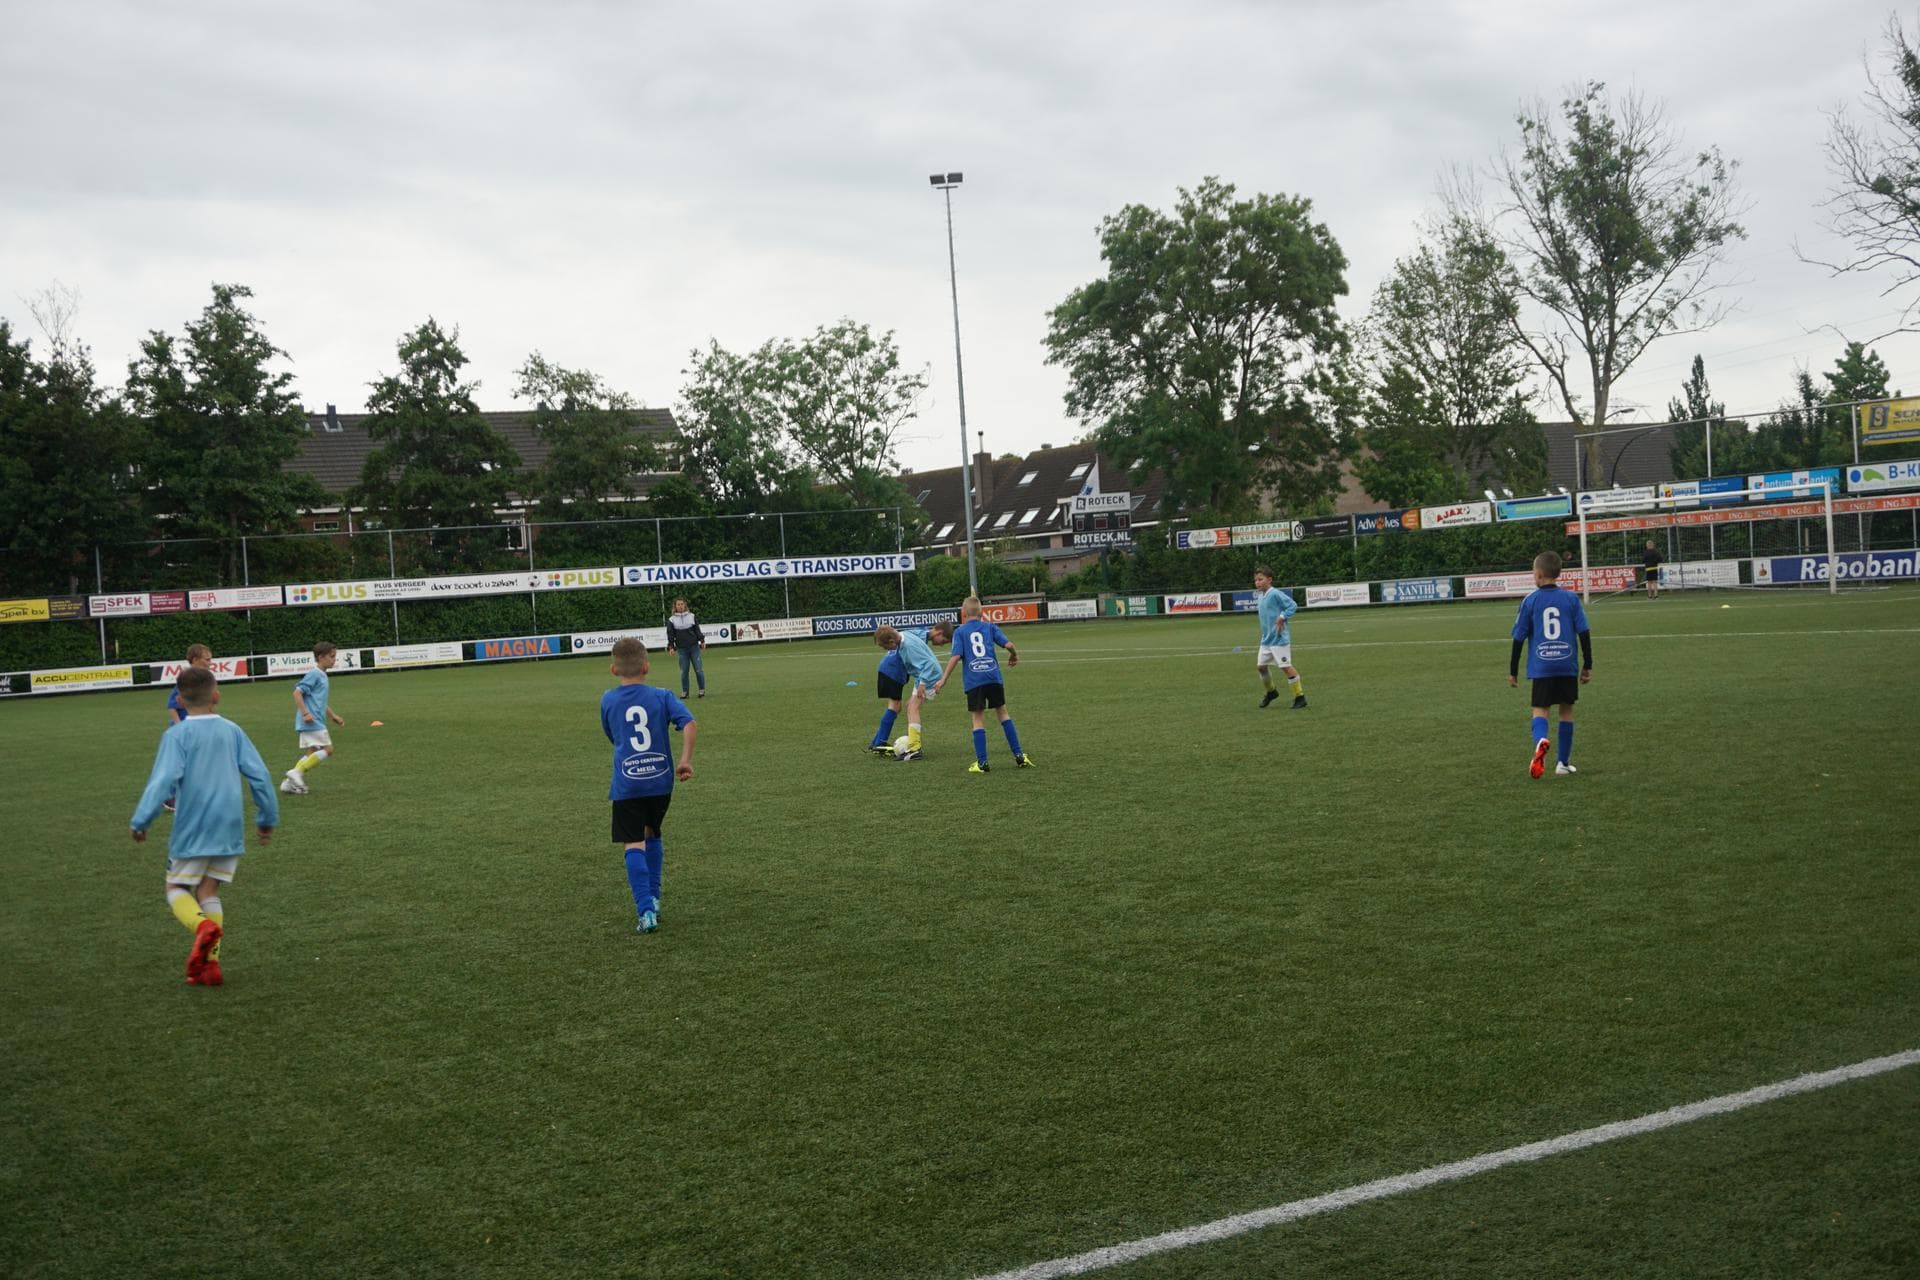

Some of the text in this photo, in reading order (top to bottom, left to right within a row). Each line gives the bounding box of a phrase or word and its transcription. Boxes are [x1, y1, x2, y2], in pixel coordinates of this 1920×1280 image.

[1088, 496, 1125, 506] ROTECK
[1436, 507, 1463, 522] AJAX
[1619, 521, 1632, 529] ING
[1787, 507, 1801, 515] ING
[1883, 501, 1900, 509] ING
[1073, 532, 1131, 544] ROTECK.NL
[644, 556, 896, 582] TANKOPSLAG TRANSPORT
[374, 580, 426, 590] PLUS VERGEER
[563, 570, 614, 587] PLUS
[311, 584, 367, 601] PLUS
[1397, 583, 1435, 596] XANTHI
[108, 597, 143, 608] SPEK
[816, 619, 844, 632] KOOS
[845, 618, 872, 631] ROOK
[874, 612, 958, 628] VERZEKERINGEN
[979, 610, 1004, 622] NG
[1543, 607, 1561, 640] 6
[485, 639, 551, 657] MAGNA
[586, 637, 596, 645] de
[970, 631, 986, 658] 8
[282, 655, 310, 666] Visser
[35, 671, 122, 683] ACCUCENTRALE
[625, 705, 651, 752] 3
